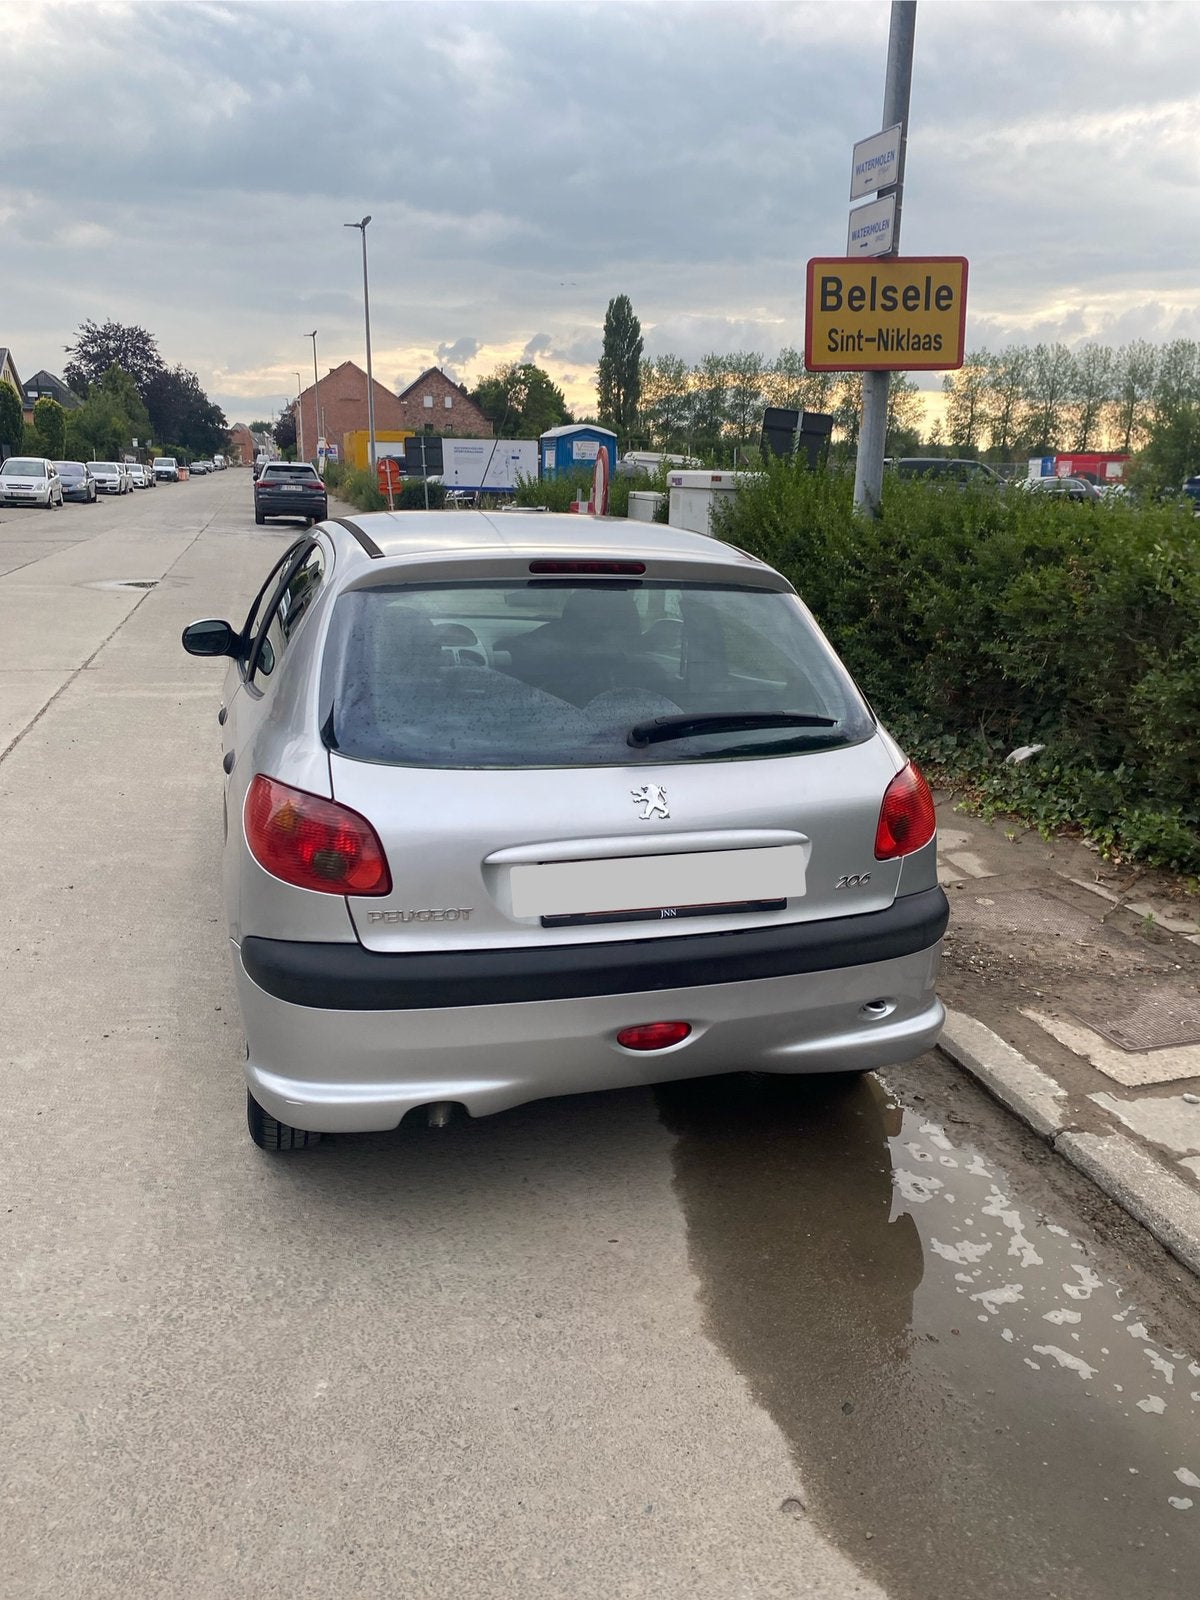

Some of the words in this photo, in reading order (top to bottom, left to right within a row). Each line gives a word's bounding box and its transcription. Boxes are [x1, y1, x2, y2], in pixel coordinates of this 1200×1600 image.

[855, 150, 896, 176] WATERMOLEN
[851, 219, 890, 241] WATERMOLEN
[820, 276, 953, 312] Belsele
[828, 328, 943, 352] Sint-Niklaas
[835, 871, 872, 889] 206
[367, 907, 473, 924] PEUGEOT
[660, 908, 677, 919] JNN
